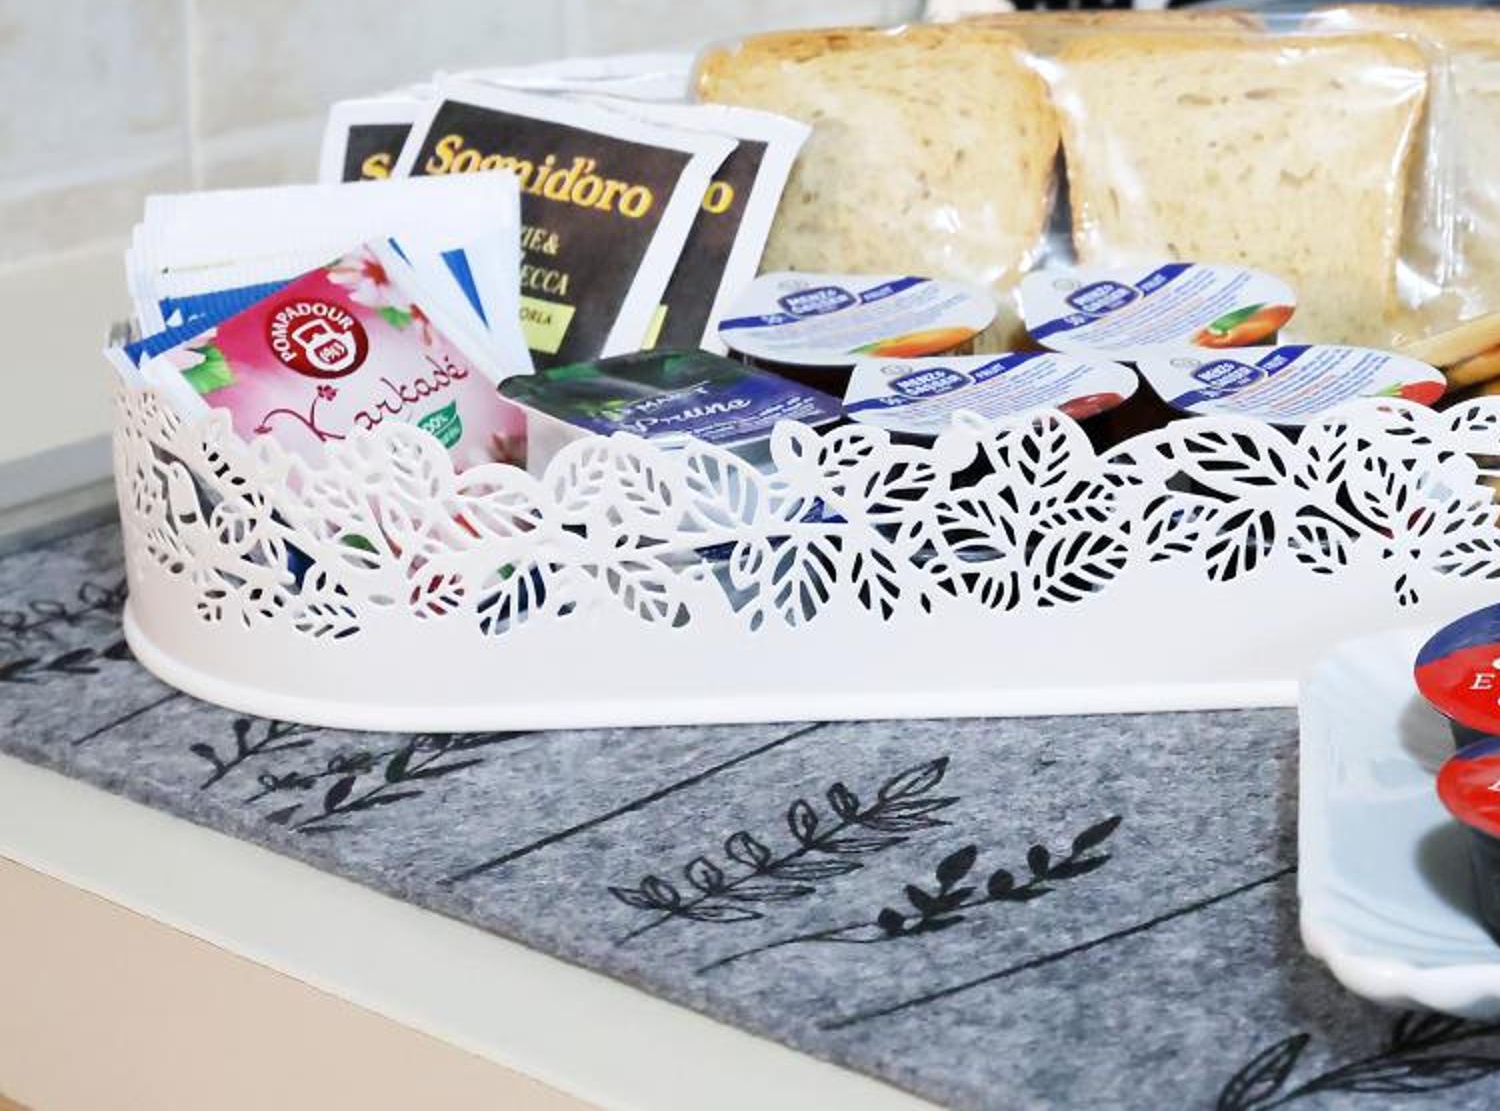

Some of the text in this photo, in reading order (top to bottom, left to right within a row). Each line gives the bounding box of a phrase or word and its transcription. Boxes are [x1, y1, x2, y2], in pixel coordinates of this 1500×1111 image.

[519, 264, 569, 296] ECCA
[271, 301, 354, 363] POMPADOUR
[1471, 672, 1495, 690] E
